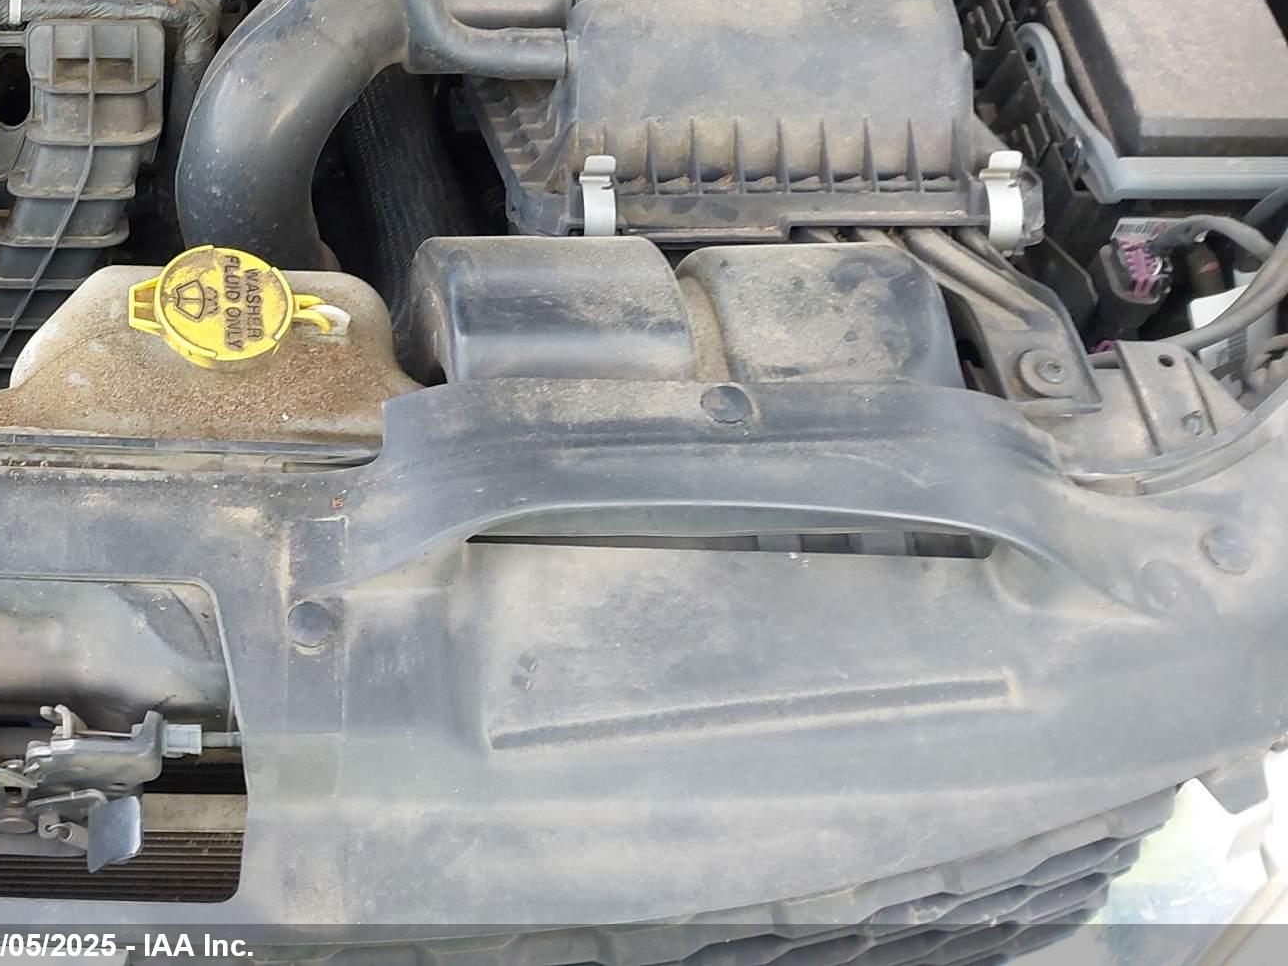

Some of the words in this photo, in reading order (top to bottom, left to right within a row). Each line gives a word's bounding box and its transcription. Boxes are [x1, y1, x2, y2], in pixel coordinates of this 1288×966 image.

[223, 255, 241, 303] FLUID
[225, 306, 244, 349] ONLY
[244, 268, 263, 339] WASHER
